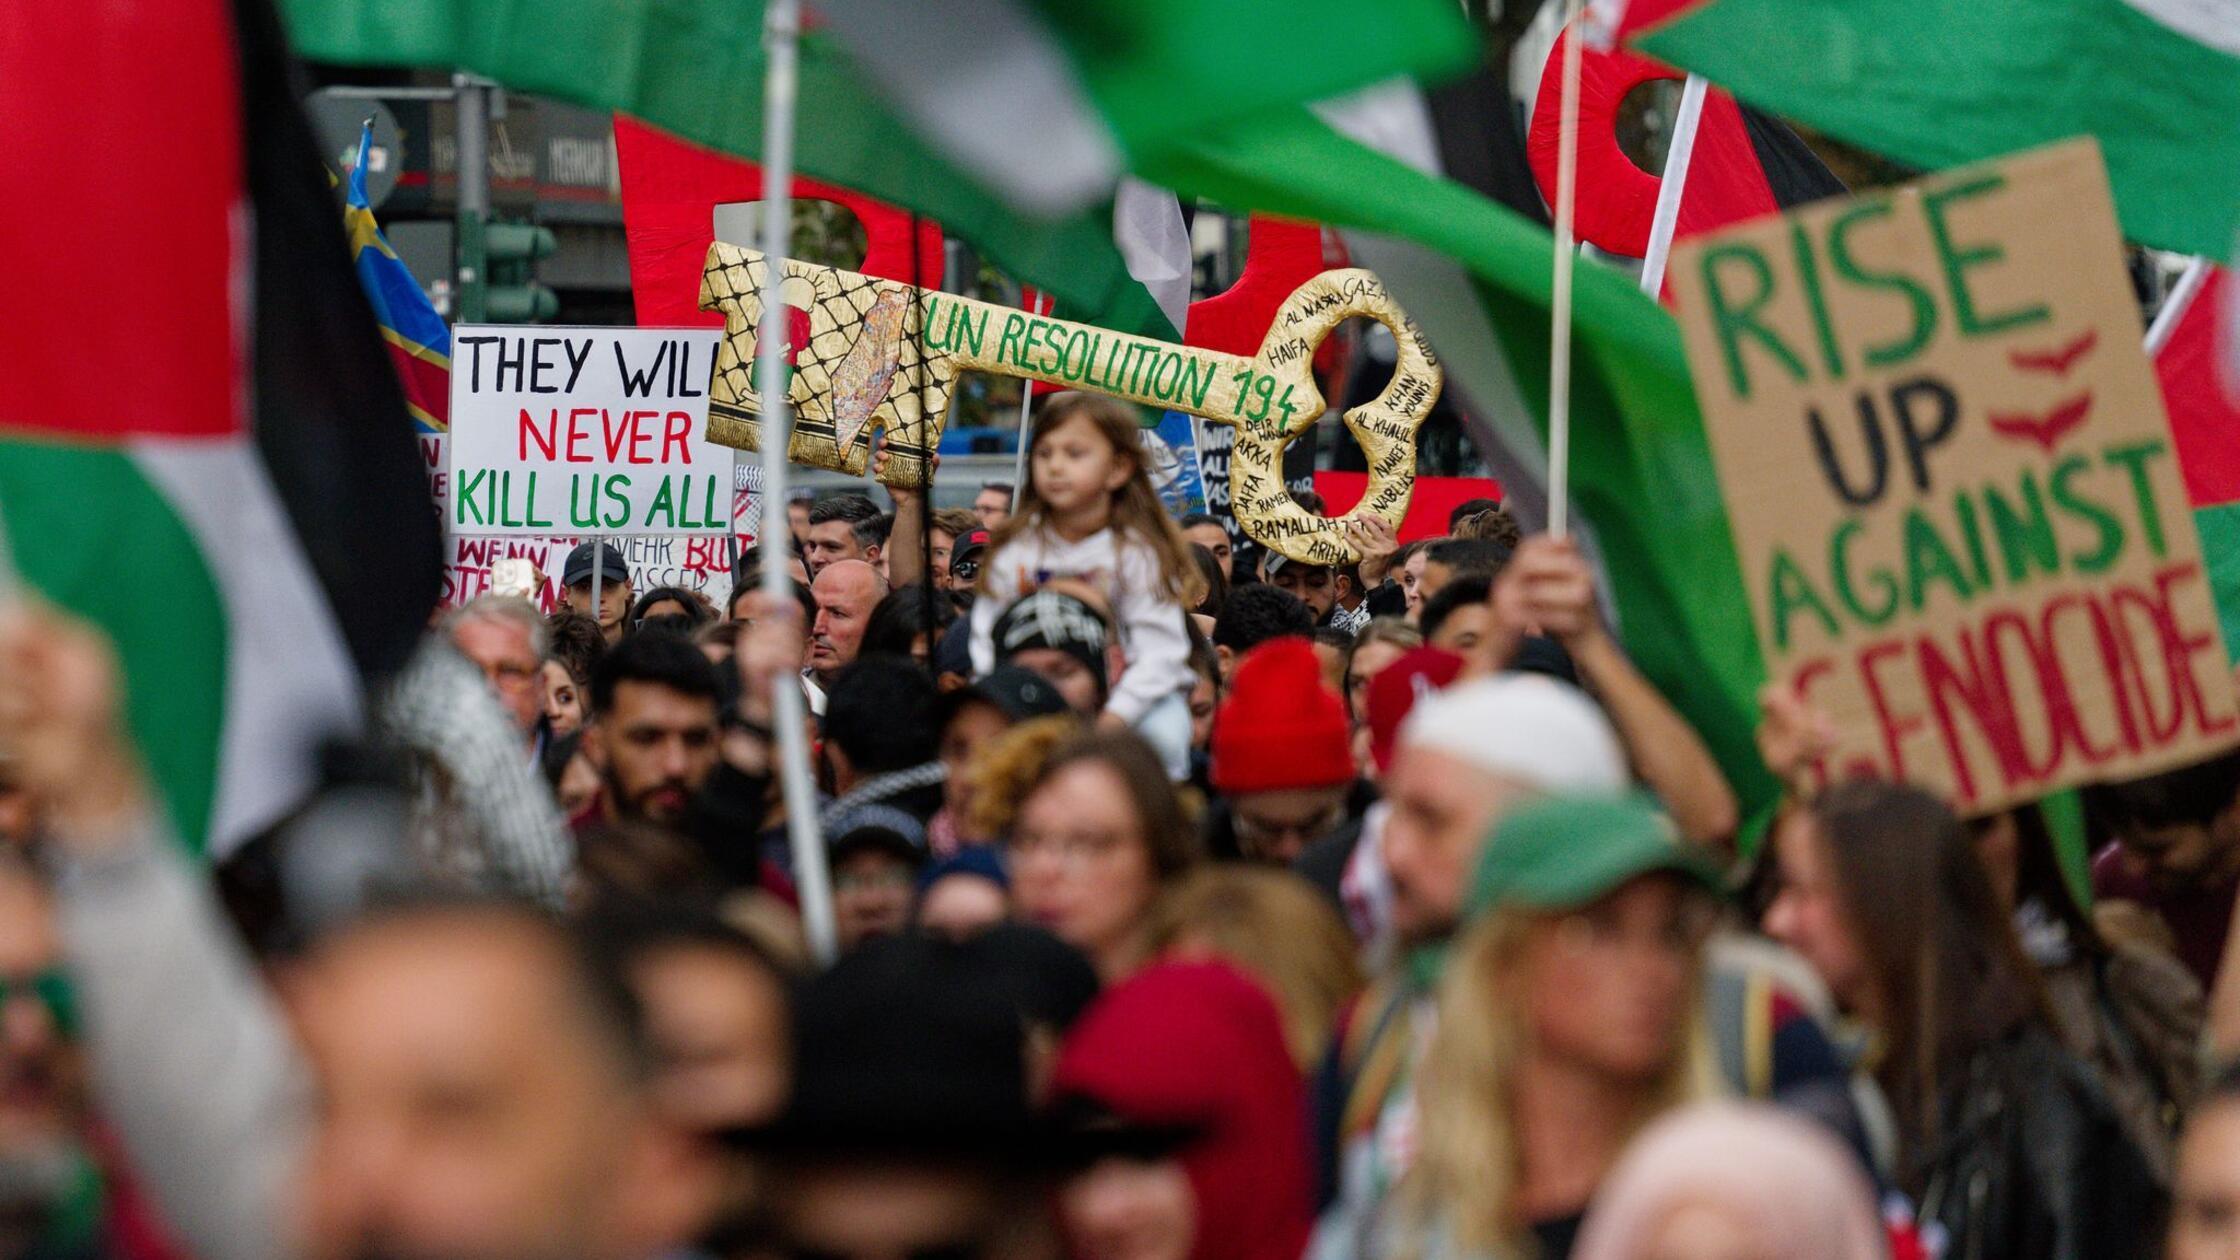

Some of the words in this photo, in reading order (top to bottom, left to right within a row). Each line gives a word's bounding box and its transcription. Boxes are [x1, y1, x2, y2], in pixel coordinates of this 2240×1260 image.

[1343, 277, 1389, 305] GAZA
[1699, 175, 2053, 399] RISE
[1285, 310, 1303, 327] AL
[458, 336, 593, 394] THEY
[923, 297, 989, 358] UN
[998, 313, 1217, 409] RESOLUTION
[1233, 370, 1298, 431] 194
[1266, 337, 1311, 369] HAIFA
[1384, 368, 1418, 411] KHAN
[1399, 380, 1430, 418] YOUNIS
[519, 408, 692, 465] NEVER
[1201, 424, 1236, 451] WIR
[1246, 418, 1273, 432] DEIR
[1354, 411, 1370, 430] AL
[1373, 417, 1411, 443] KHALIL
[1807, 375, 1960, 507] UP
[1234, 437, 1271, 472] AKKA
[1374, 444, 1406, 478] NAHEF
[457, 469, 553, 528] KILL
[570, 473, 632, 529] US
[645, 473, 727, 529] ALL
[1234, 474, 1265, 515] JAFFA
[1372, 470, 1414, 513] NABLUS
[1252, 516, 1338, 539] RAMALLAH
[1307, 540, 1349, 563] ARIHA
[1770, 439, 2166, 655] AGAINST
[627, 566, 709, 596] ASSER
